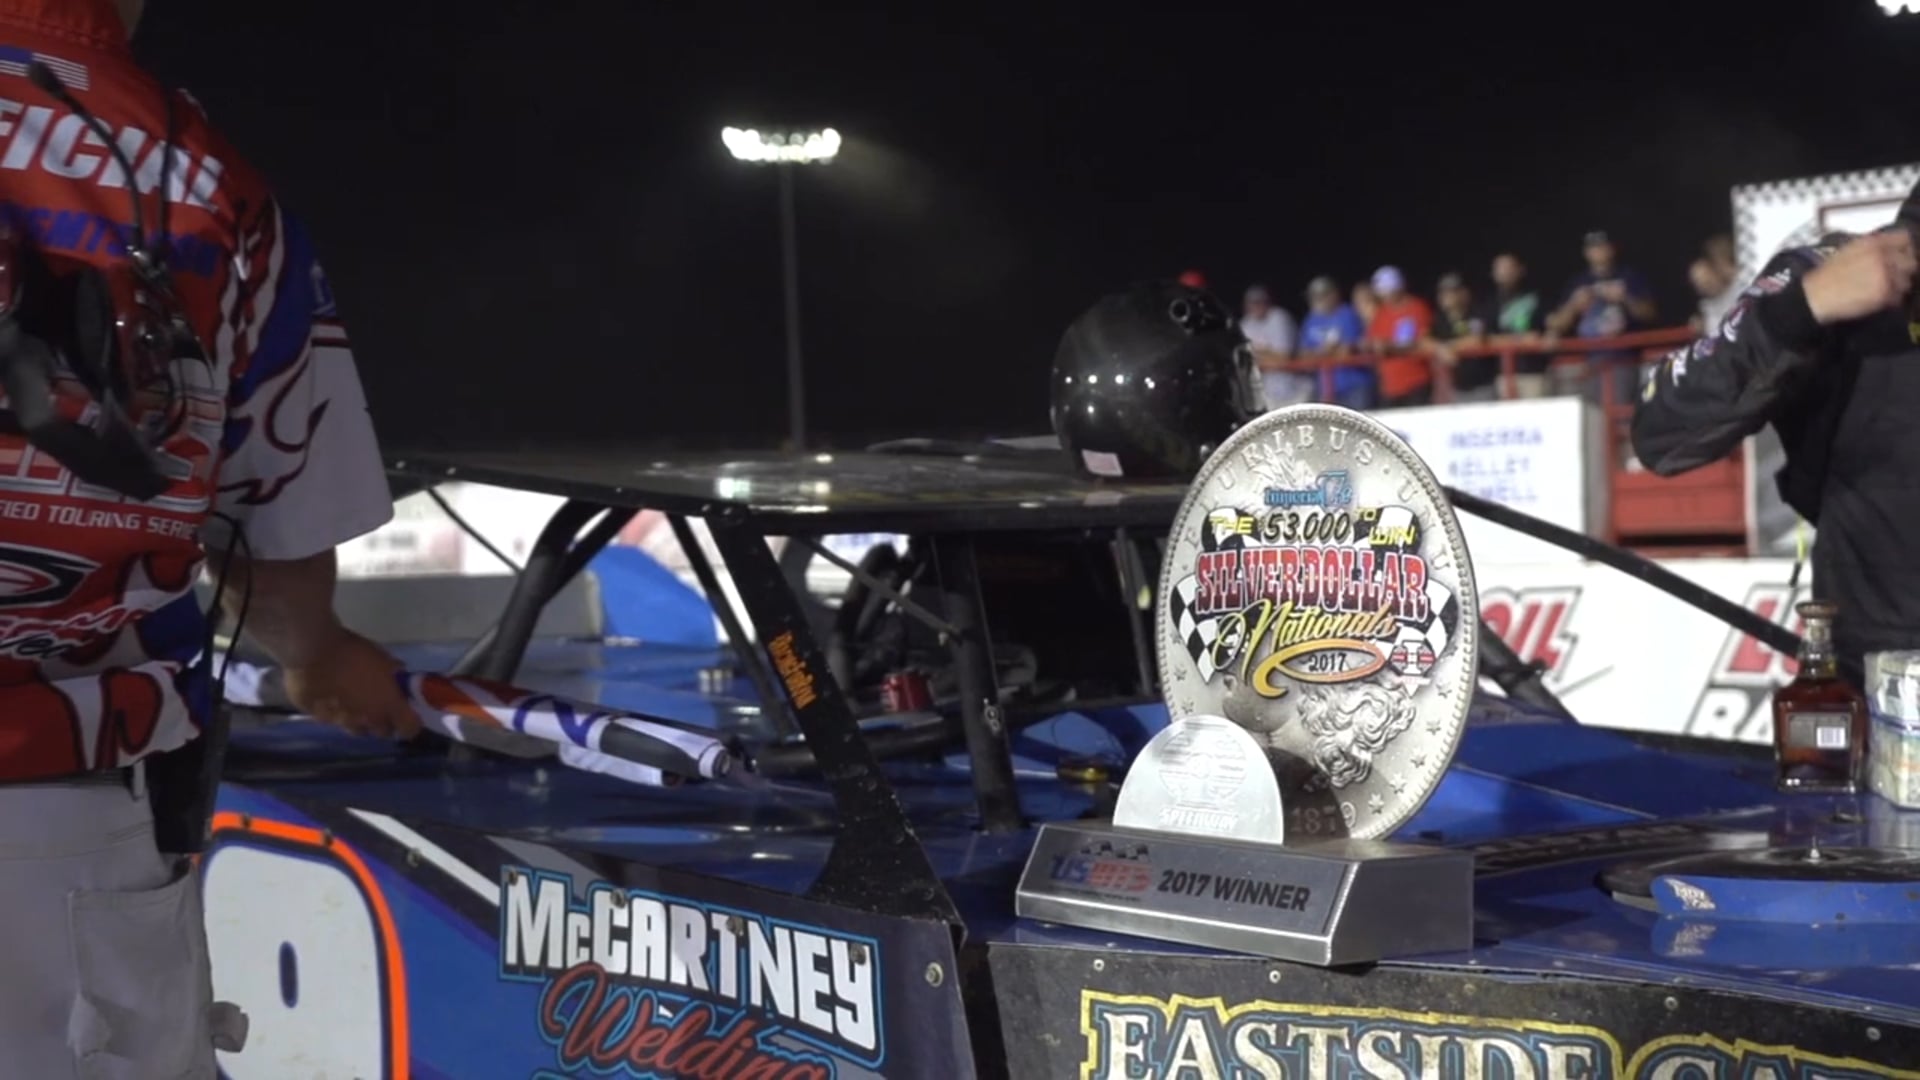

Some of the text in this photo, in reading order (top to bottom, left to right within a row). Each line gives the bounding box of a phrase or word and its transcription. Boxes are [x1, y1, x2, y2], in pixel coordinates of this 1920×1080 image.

[48, 505, 142, 530] TOURING
[1209, 515, 1254, 534] THE
[1368, 525, 1416, 546] WIN
[1194, 546, 1430, 623] SILVERDOLLAR
[1209, 598, 1399, 686] Nationals
[1308, 652, 1347, 673] 2017
[1157, 868, 1210, 898] 2017
[1211, 875, 1311, 912] WINNER
